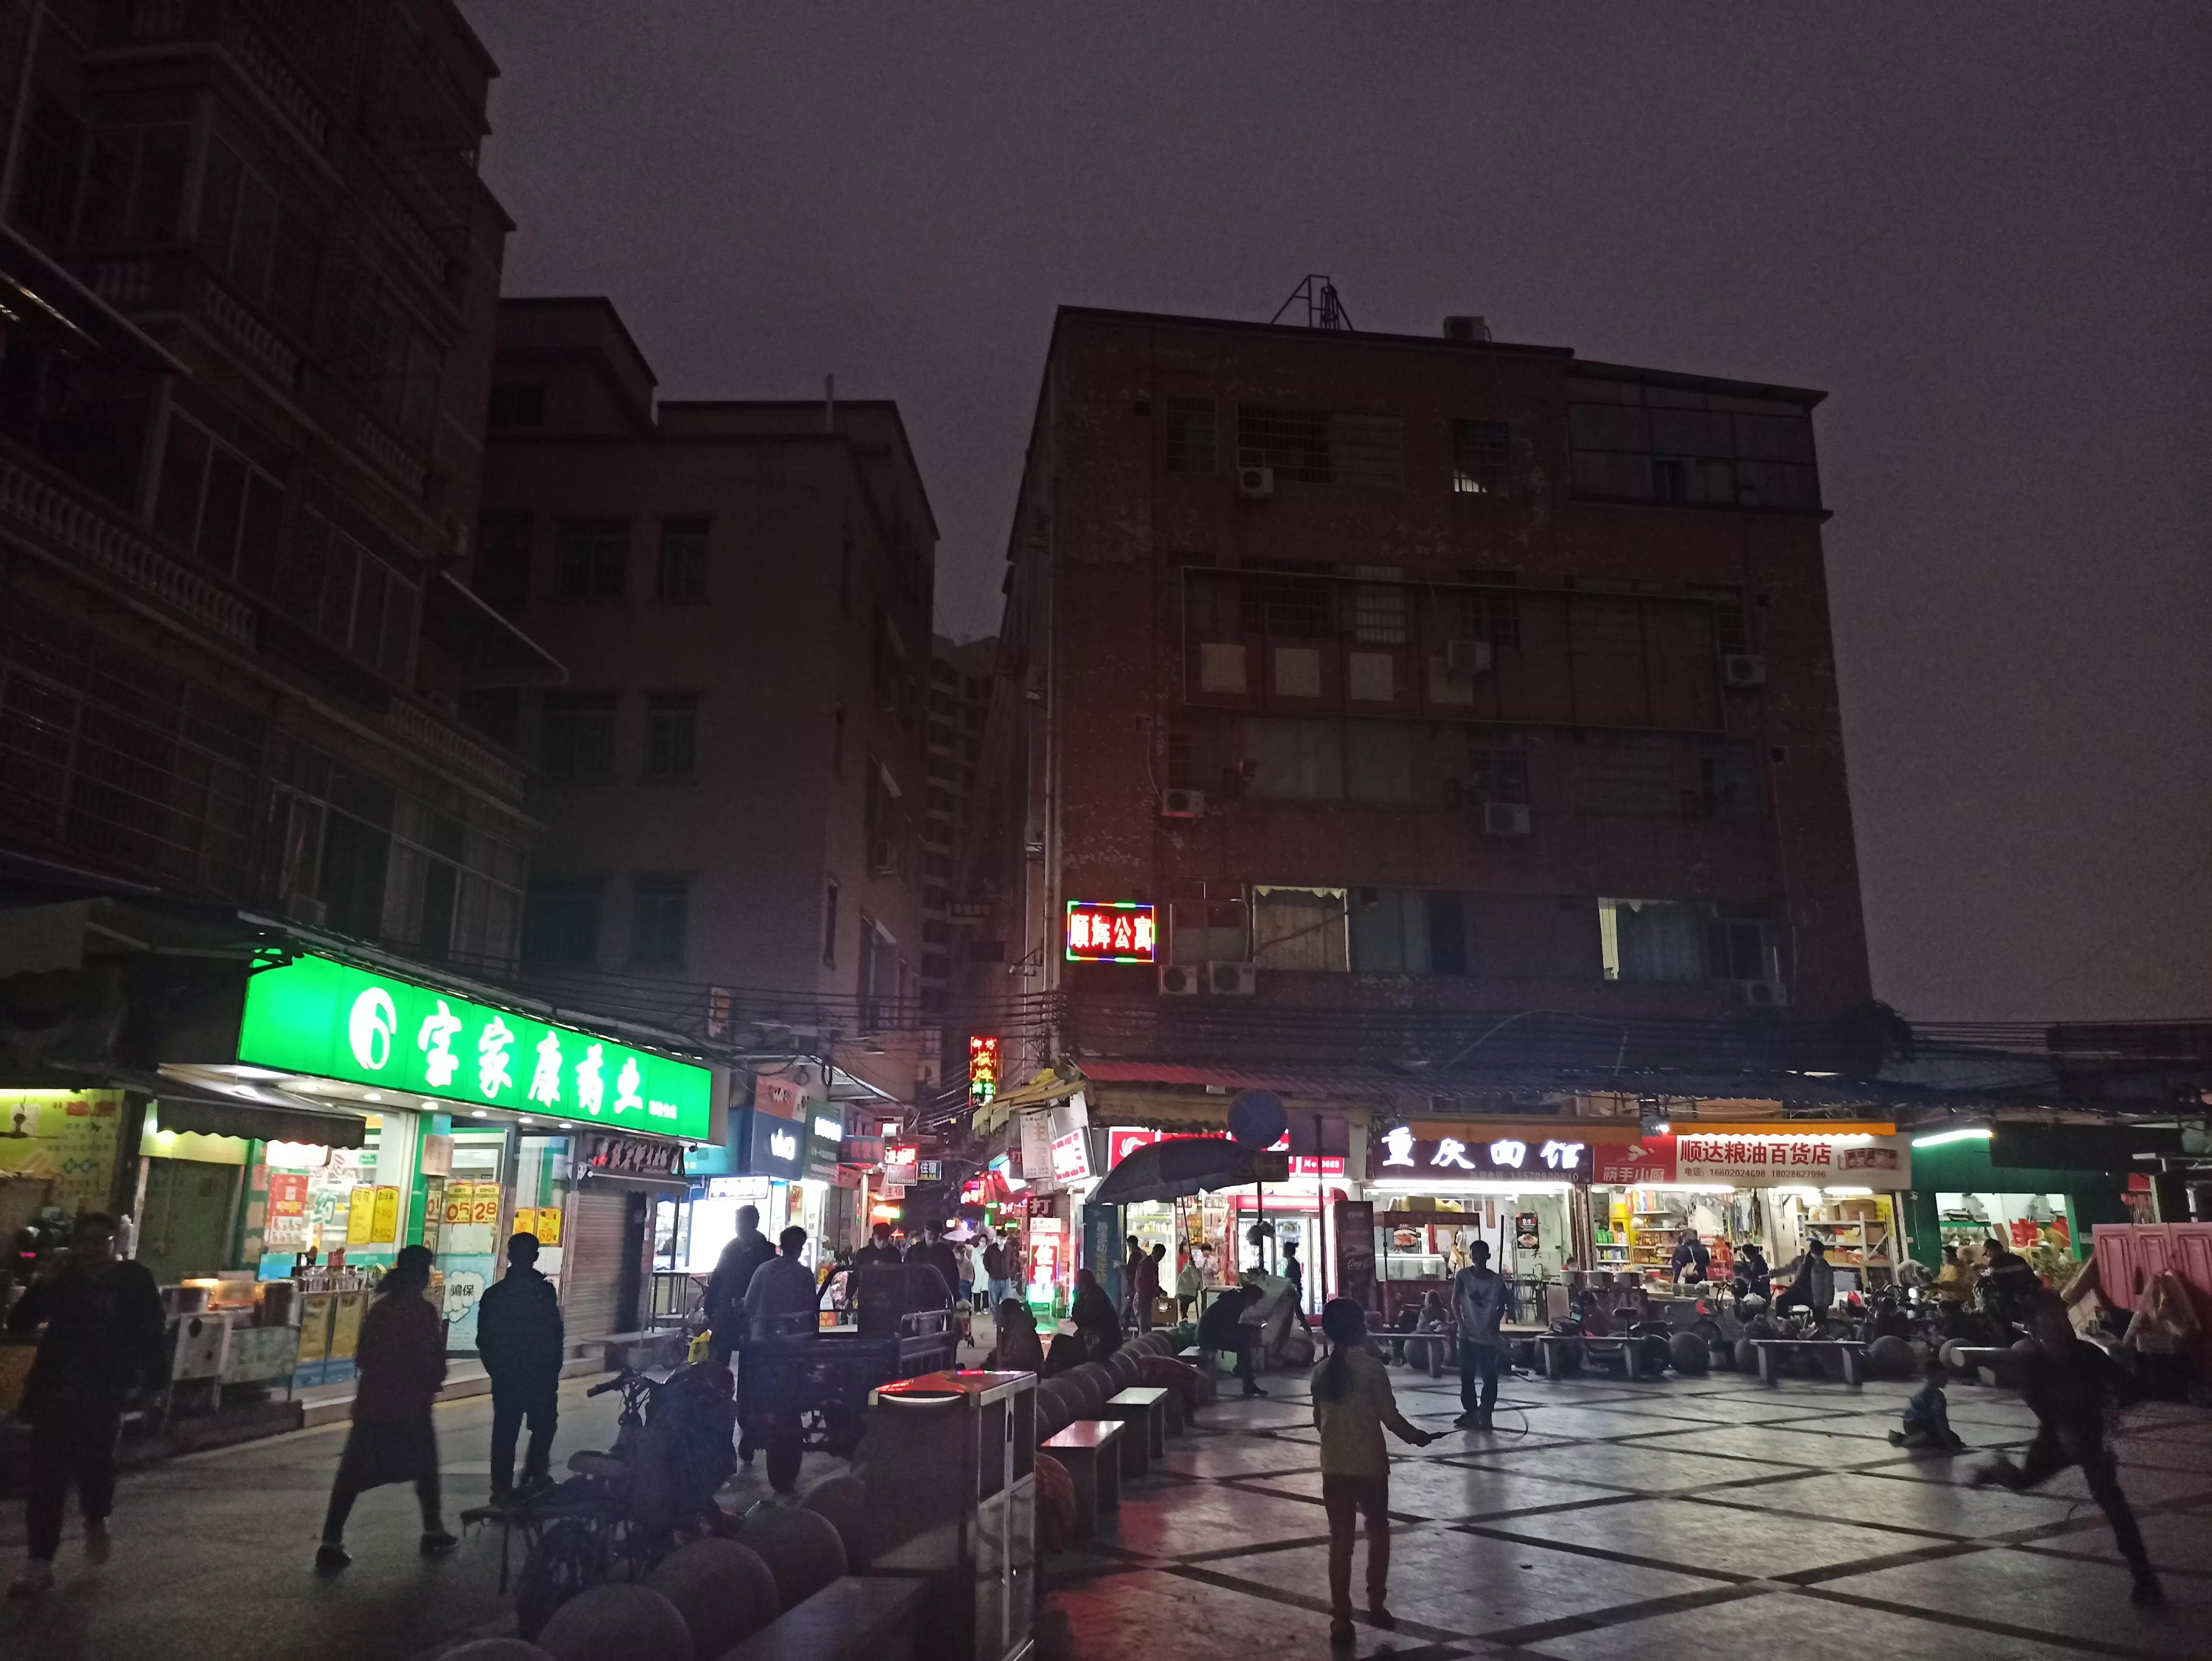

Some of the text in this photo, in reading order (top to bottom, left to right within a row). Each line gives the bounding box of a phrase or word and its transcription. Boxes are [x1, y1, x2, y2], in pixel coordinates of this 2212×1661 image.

[1680, 1140, 1832, 1165] 顺达粮油百货店
[1603, 1166, 1665, 1183] 筷手小厨
[1710, 1168, 1766, 1178] 16602024698
[1771, 1169, 1826, 1179] 18028627996
[1029, 1197, 1051, 1214] 打
[451, 1284, 474, 1296] 骗保
